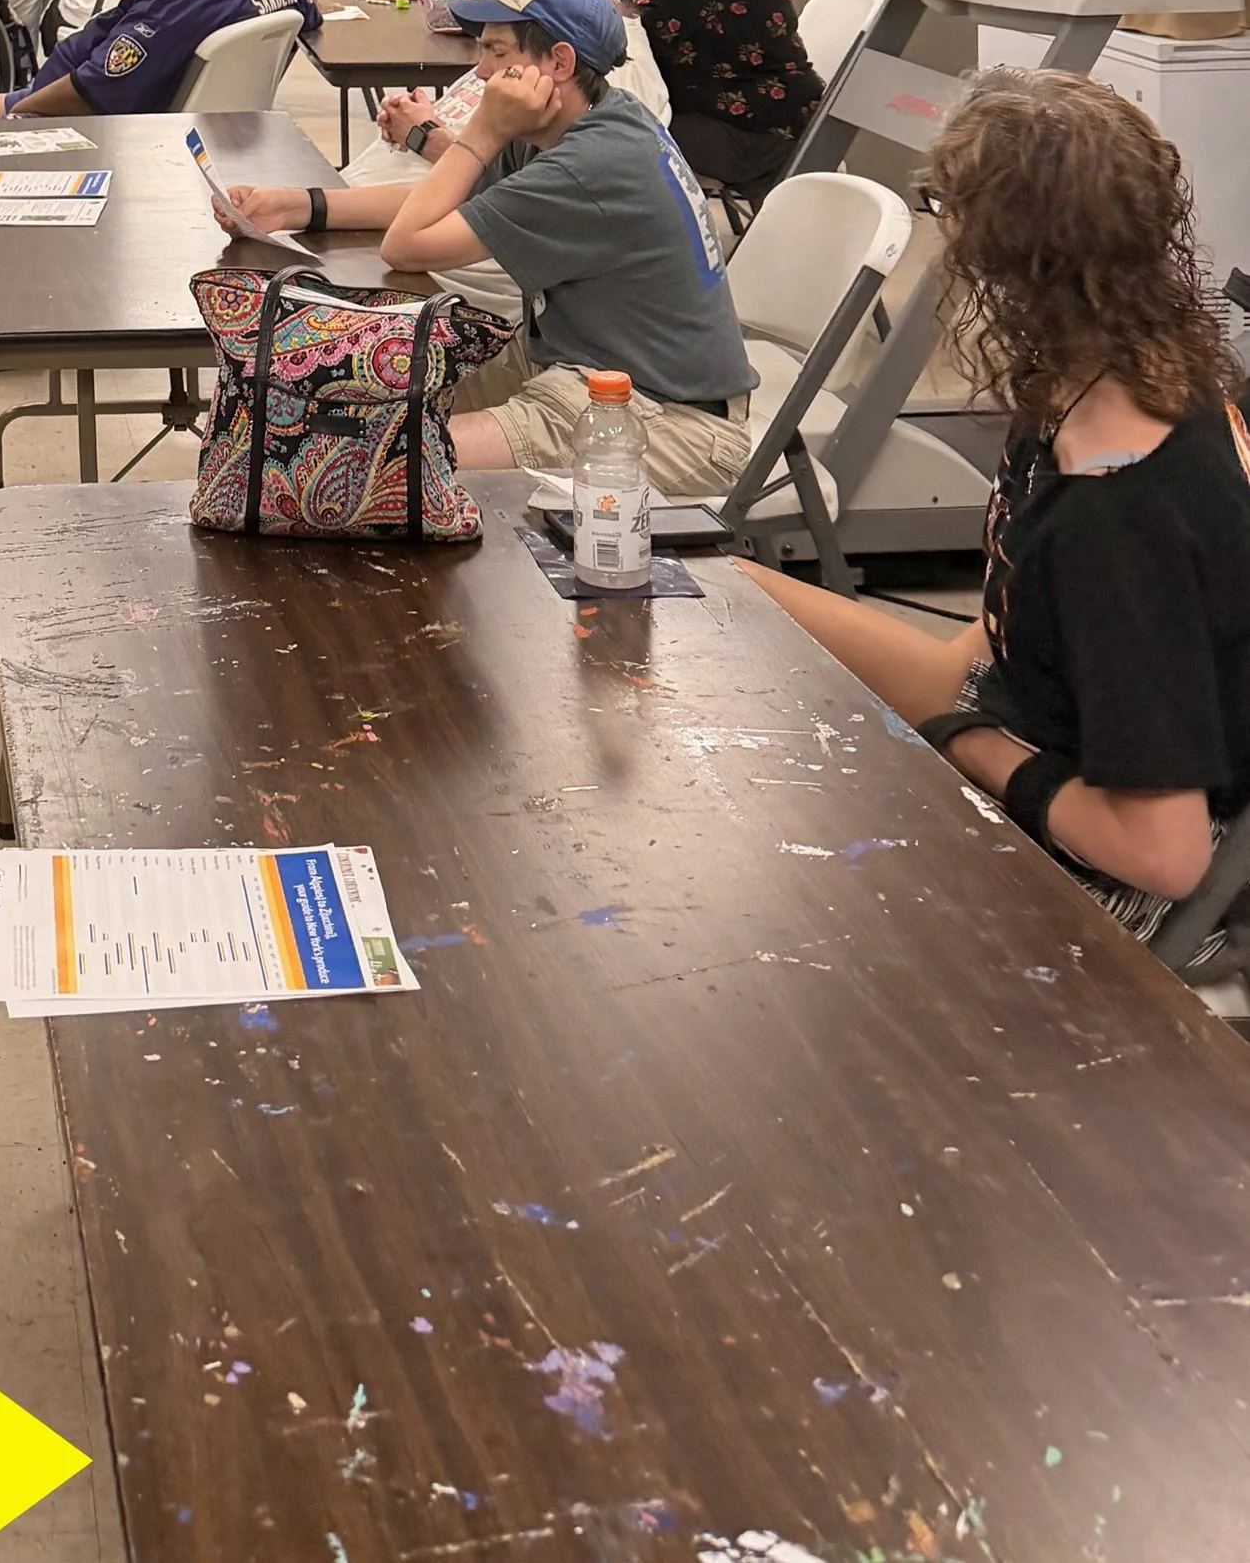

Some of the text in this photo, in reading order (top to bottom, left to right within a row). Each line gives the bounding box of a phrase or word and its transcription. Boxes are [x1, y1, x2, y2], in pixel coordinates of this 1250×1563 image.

[306, 859, 318, 876] From
[292, 883, 308, 898] your
[295, 897, 314, 916] guide
[305, 922, 318, 937] New
[310, 936, 325, 957] York's
[311, 956, 331, 984] produce
